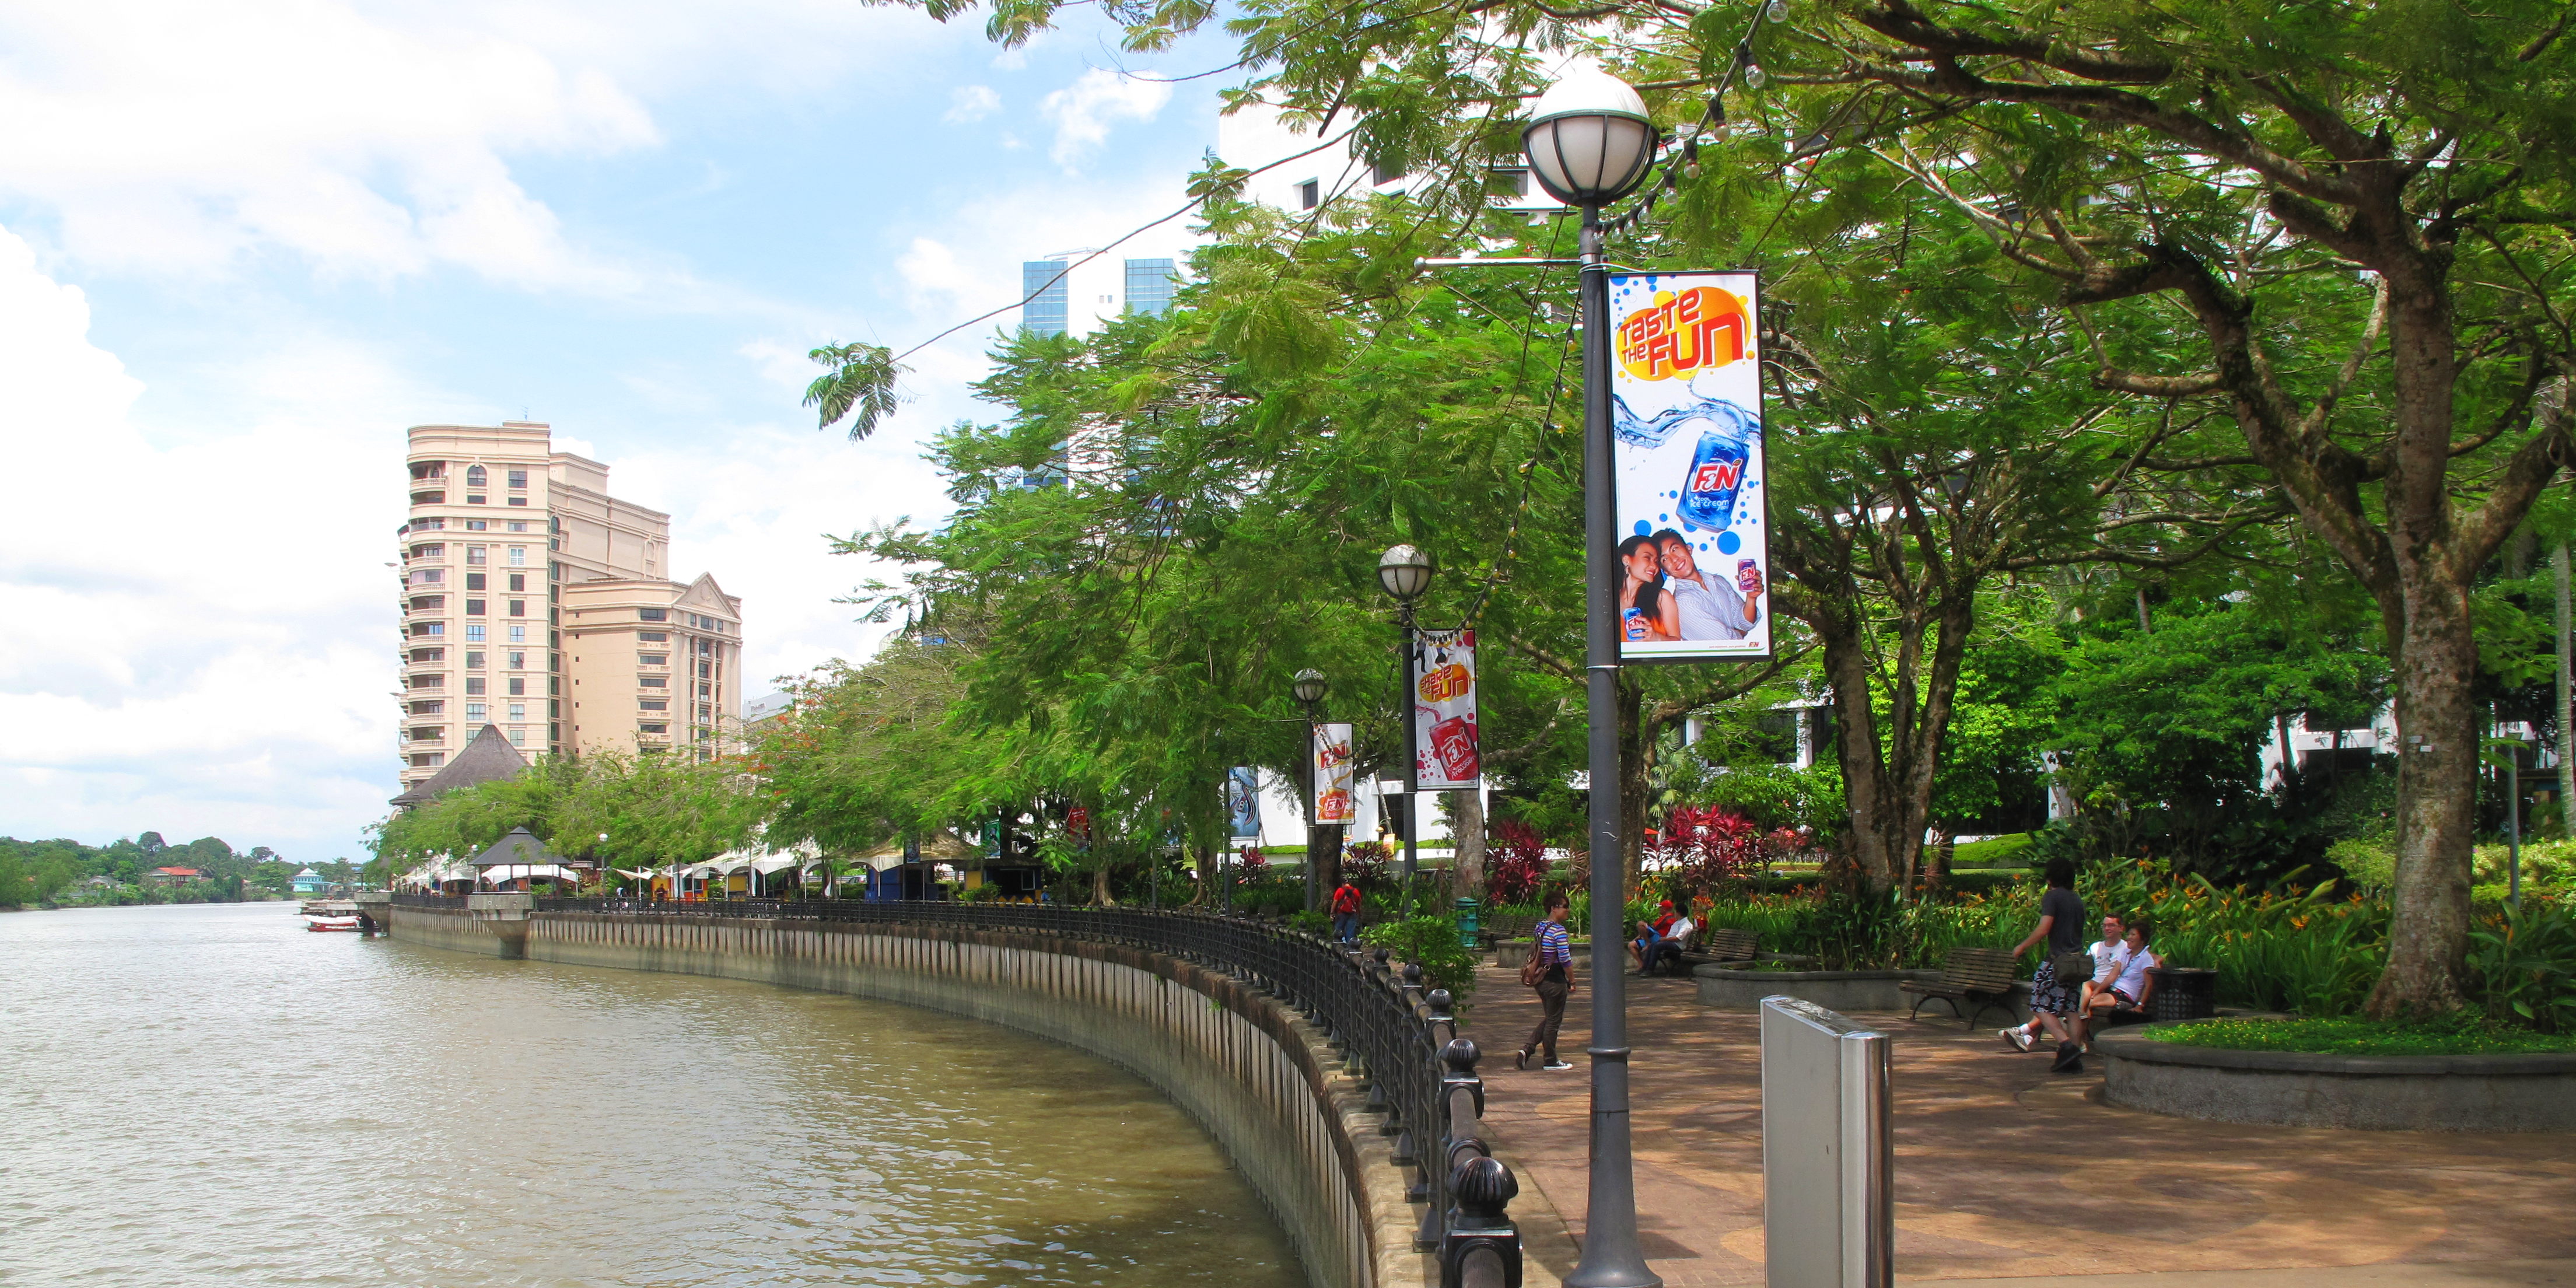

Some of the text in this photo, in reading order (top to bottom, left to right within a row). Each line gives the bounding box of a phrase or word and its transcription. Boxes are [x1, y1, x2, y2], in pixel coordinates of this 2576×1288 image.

[1692, 464, 1739, 492] F&N
[1741, 568, 1755, 580] F&N
[1320, 744, 1347, 769] F&N
[1441, 733, 1470, 768] F&N
[1326, 799, 1344, 811] F&N
